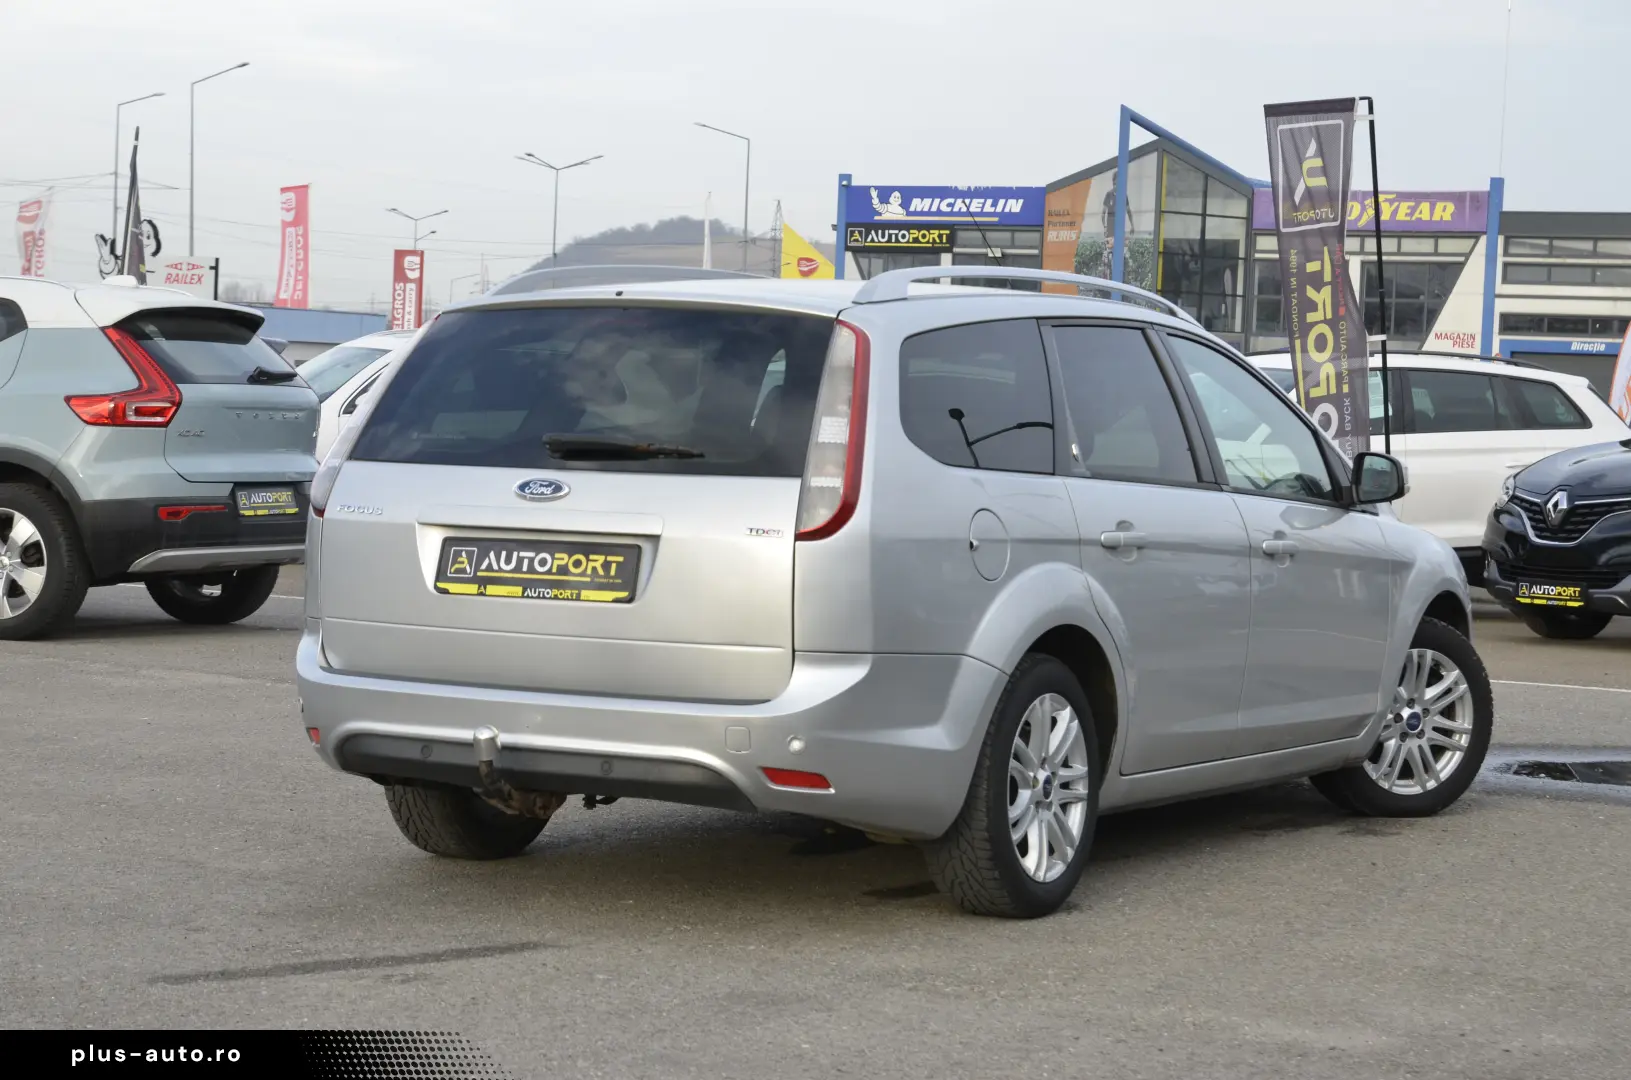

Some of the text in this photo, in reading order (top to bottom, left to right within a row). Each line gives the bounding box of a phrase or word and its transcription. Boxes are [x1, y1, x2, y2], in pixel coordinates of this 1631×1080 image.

[909, 198, 1024, 213] MICHELIN
[866, 229, 950, 243] AUTOPORT
[164, 272, 205, 285] RAILEX
[394, 283, 404, 329] ELGROS
[1434, 332, 1476, 342] MAGAZIN
[1452, 340, 1476, 349] PIESE
[524, 480, 556, 496] Ford
[250, 491, 292, 503] AUTOPORT
[336, 504, 383, 515] FOCUS
[480, 550, 625, 577] AUTOPORT
[524, 587, 579, 600] AUTOPORT
[1530, 585, 1581, 596] AUTOPORT
